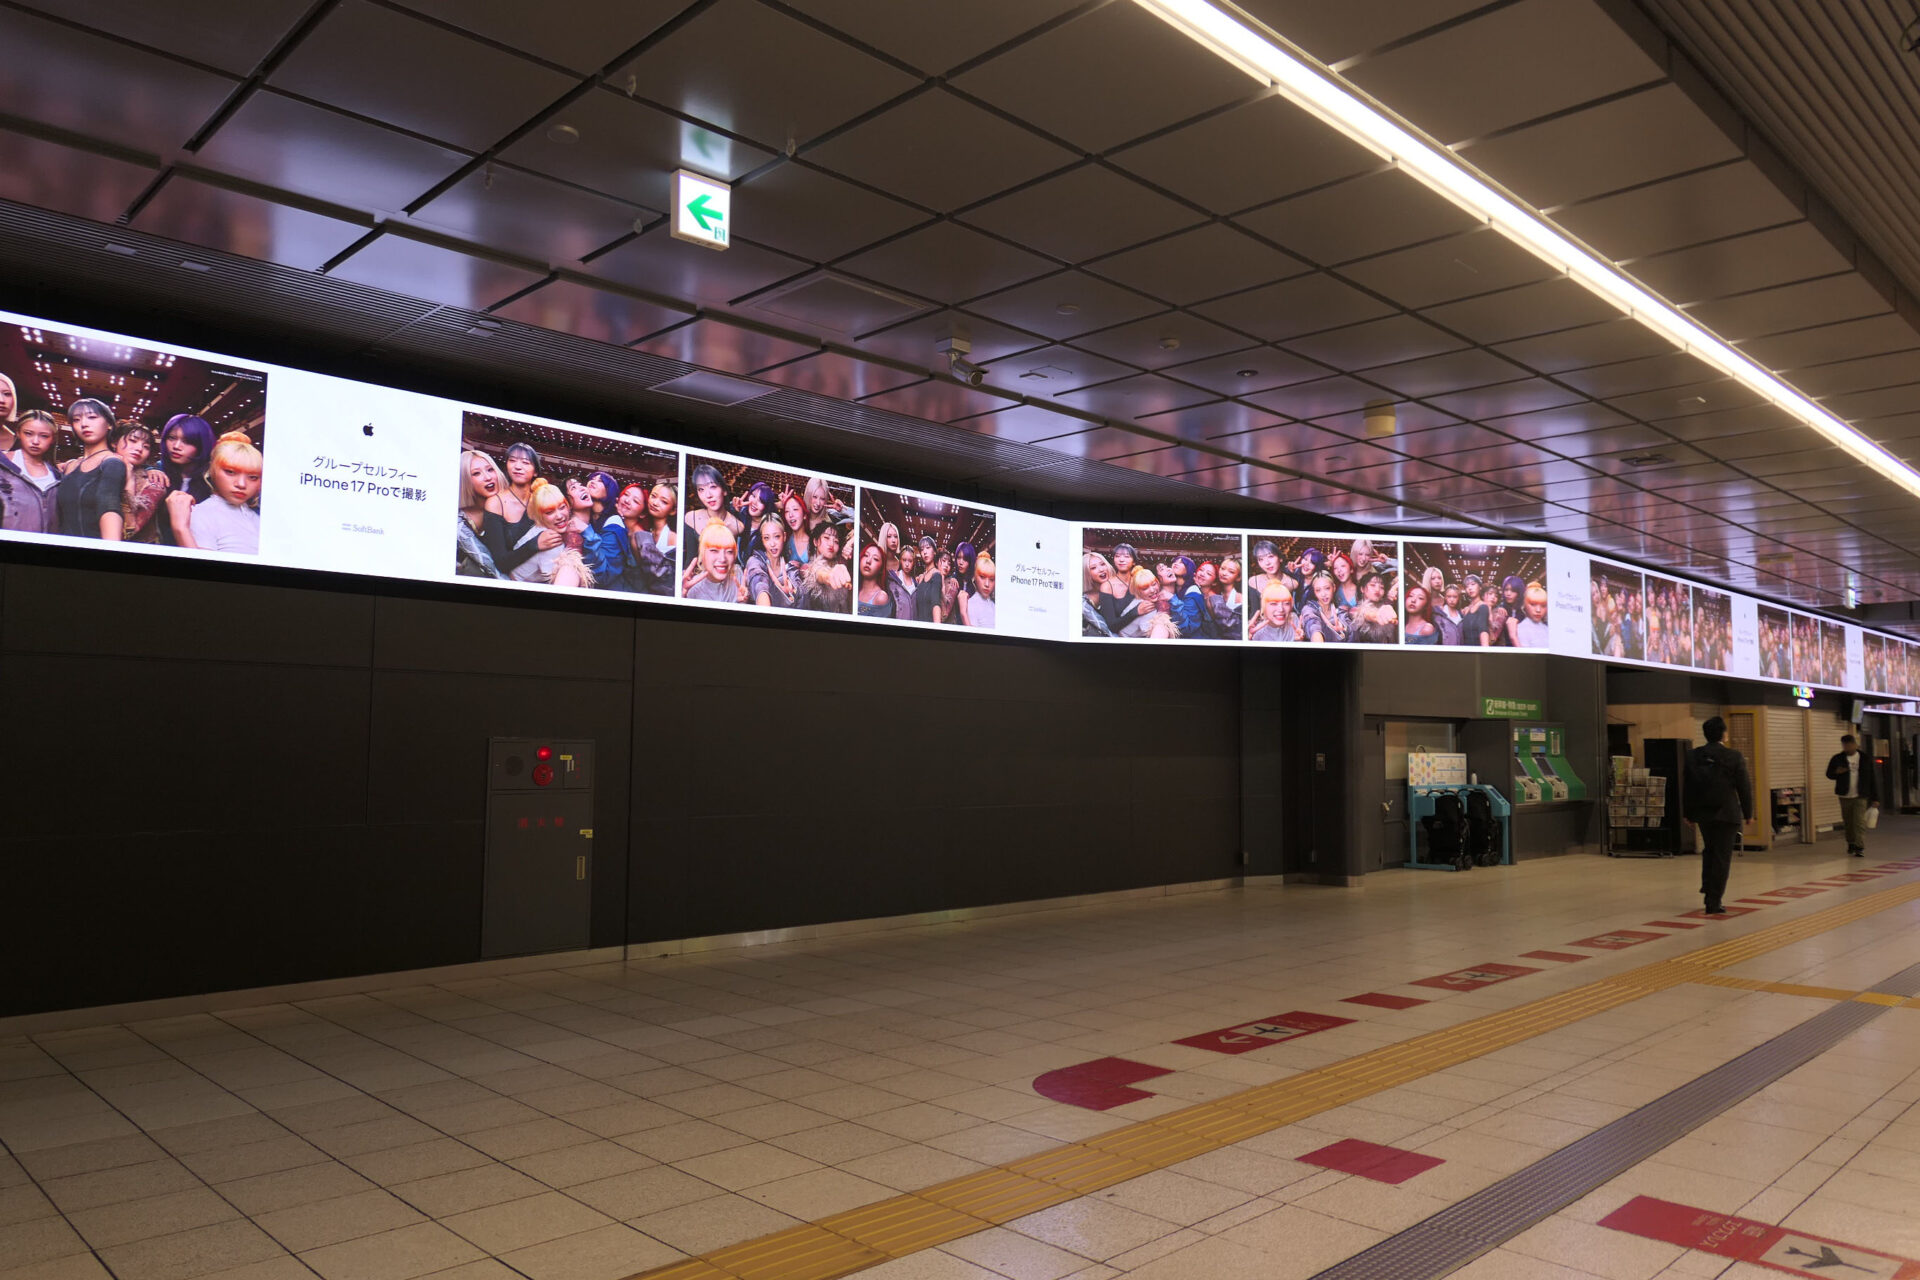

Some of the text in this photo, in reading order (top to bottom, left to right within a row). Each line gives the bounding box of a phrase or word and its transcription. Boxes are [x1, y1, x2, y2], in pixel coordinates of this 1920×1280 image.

[313, 456, 417, 480] グループセルフィー
[300, 473, 427, 502] iPhone 17 Proで撮影
[352, 524, 385, 535] SoftBank
[1011, 575, 1031, 585] iPhone
